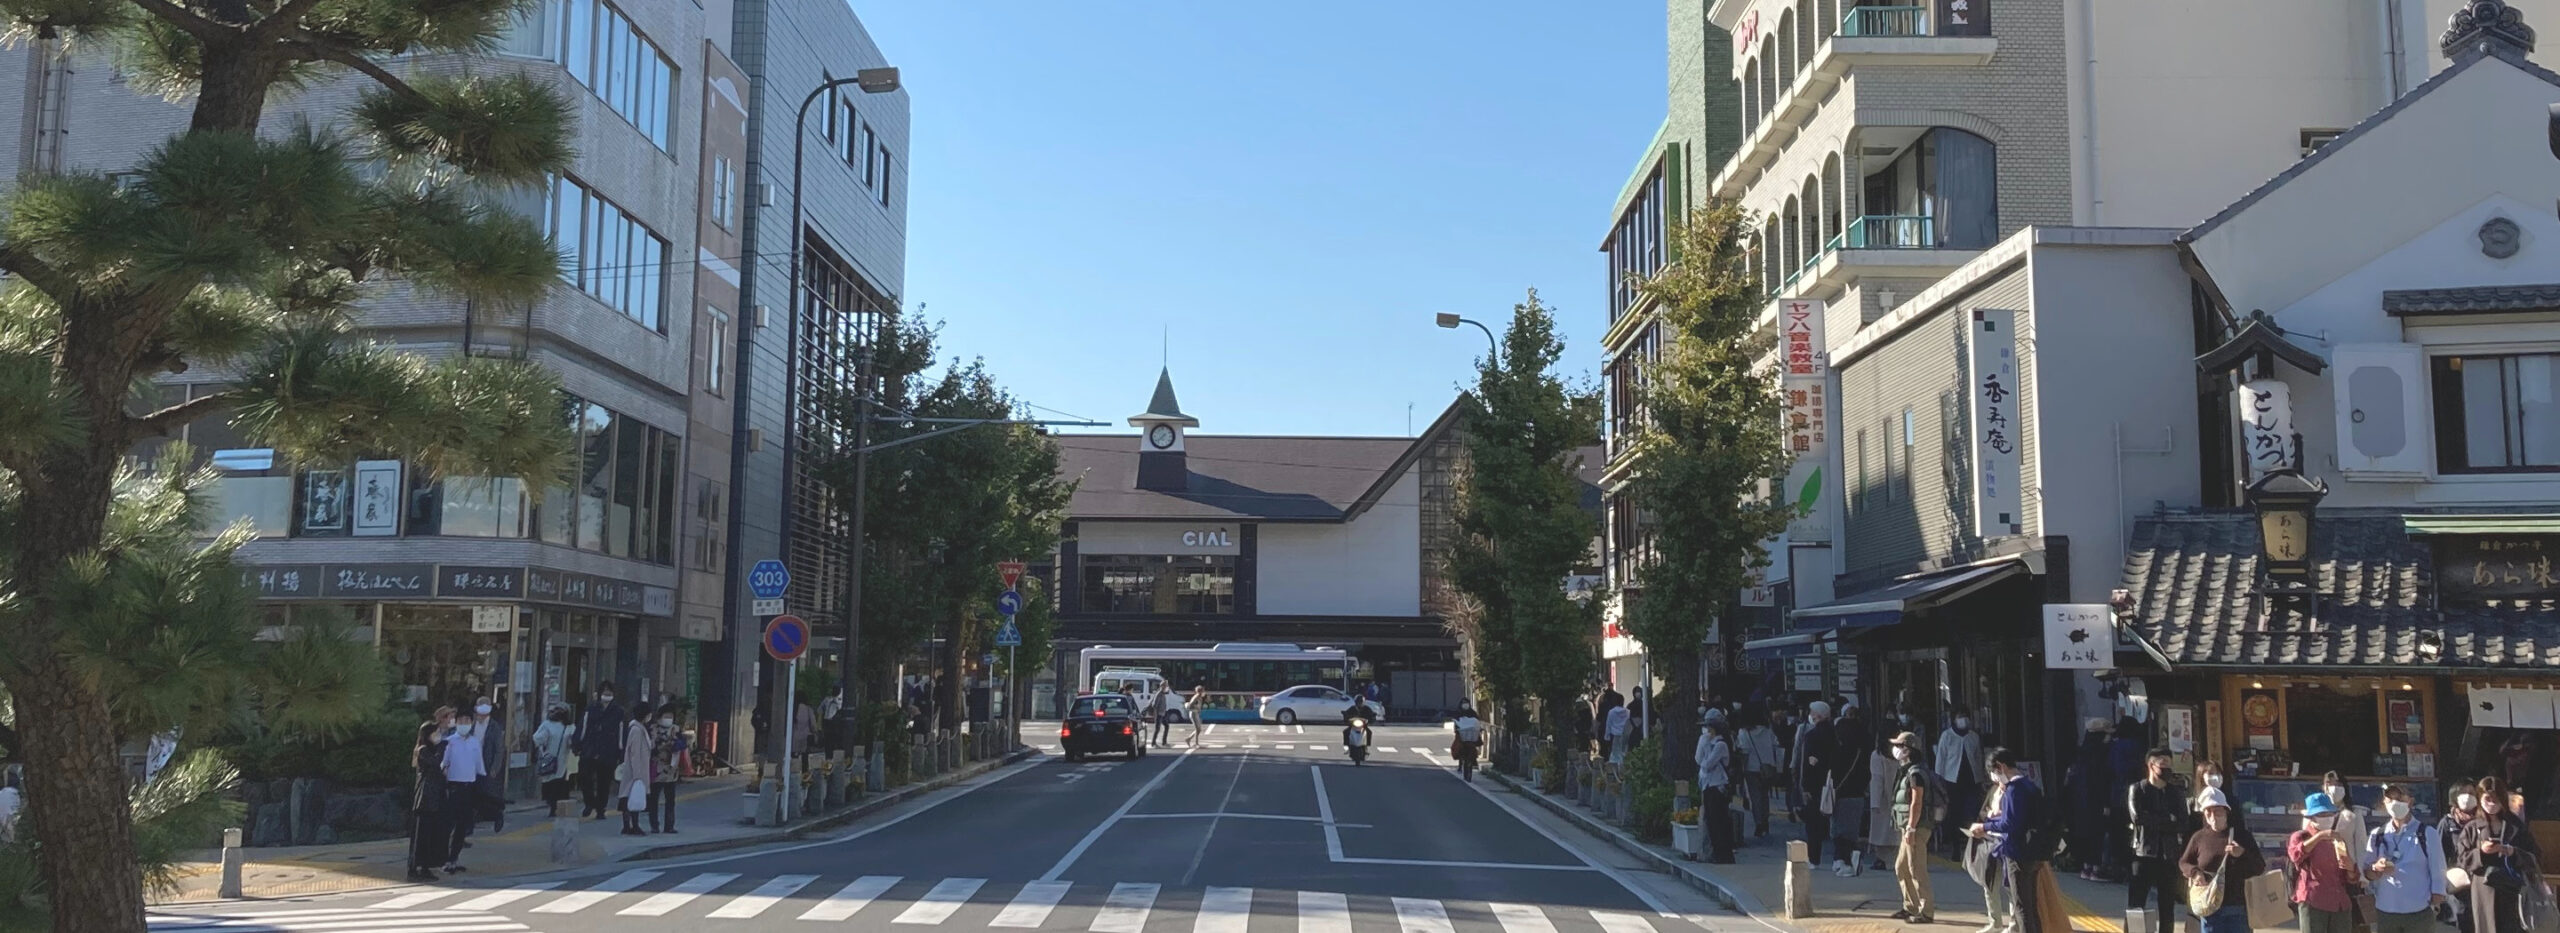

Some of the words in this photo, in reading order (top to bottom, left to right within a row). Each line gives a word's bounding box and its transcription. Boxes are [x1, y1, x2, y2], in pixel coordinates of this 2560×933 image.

[1787, 302, 1814, 374] ヤマハ音楽教室
[2254, 390, 2284, 467] とんかつ
[1182, 529, 1232, 548] CIAL
[754, 571, 784, 587] 303
[2057, 612, 2100, 622] とんかつ
